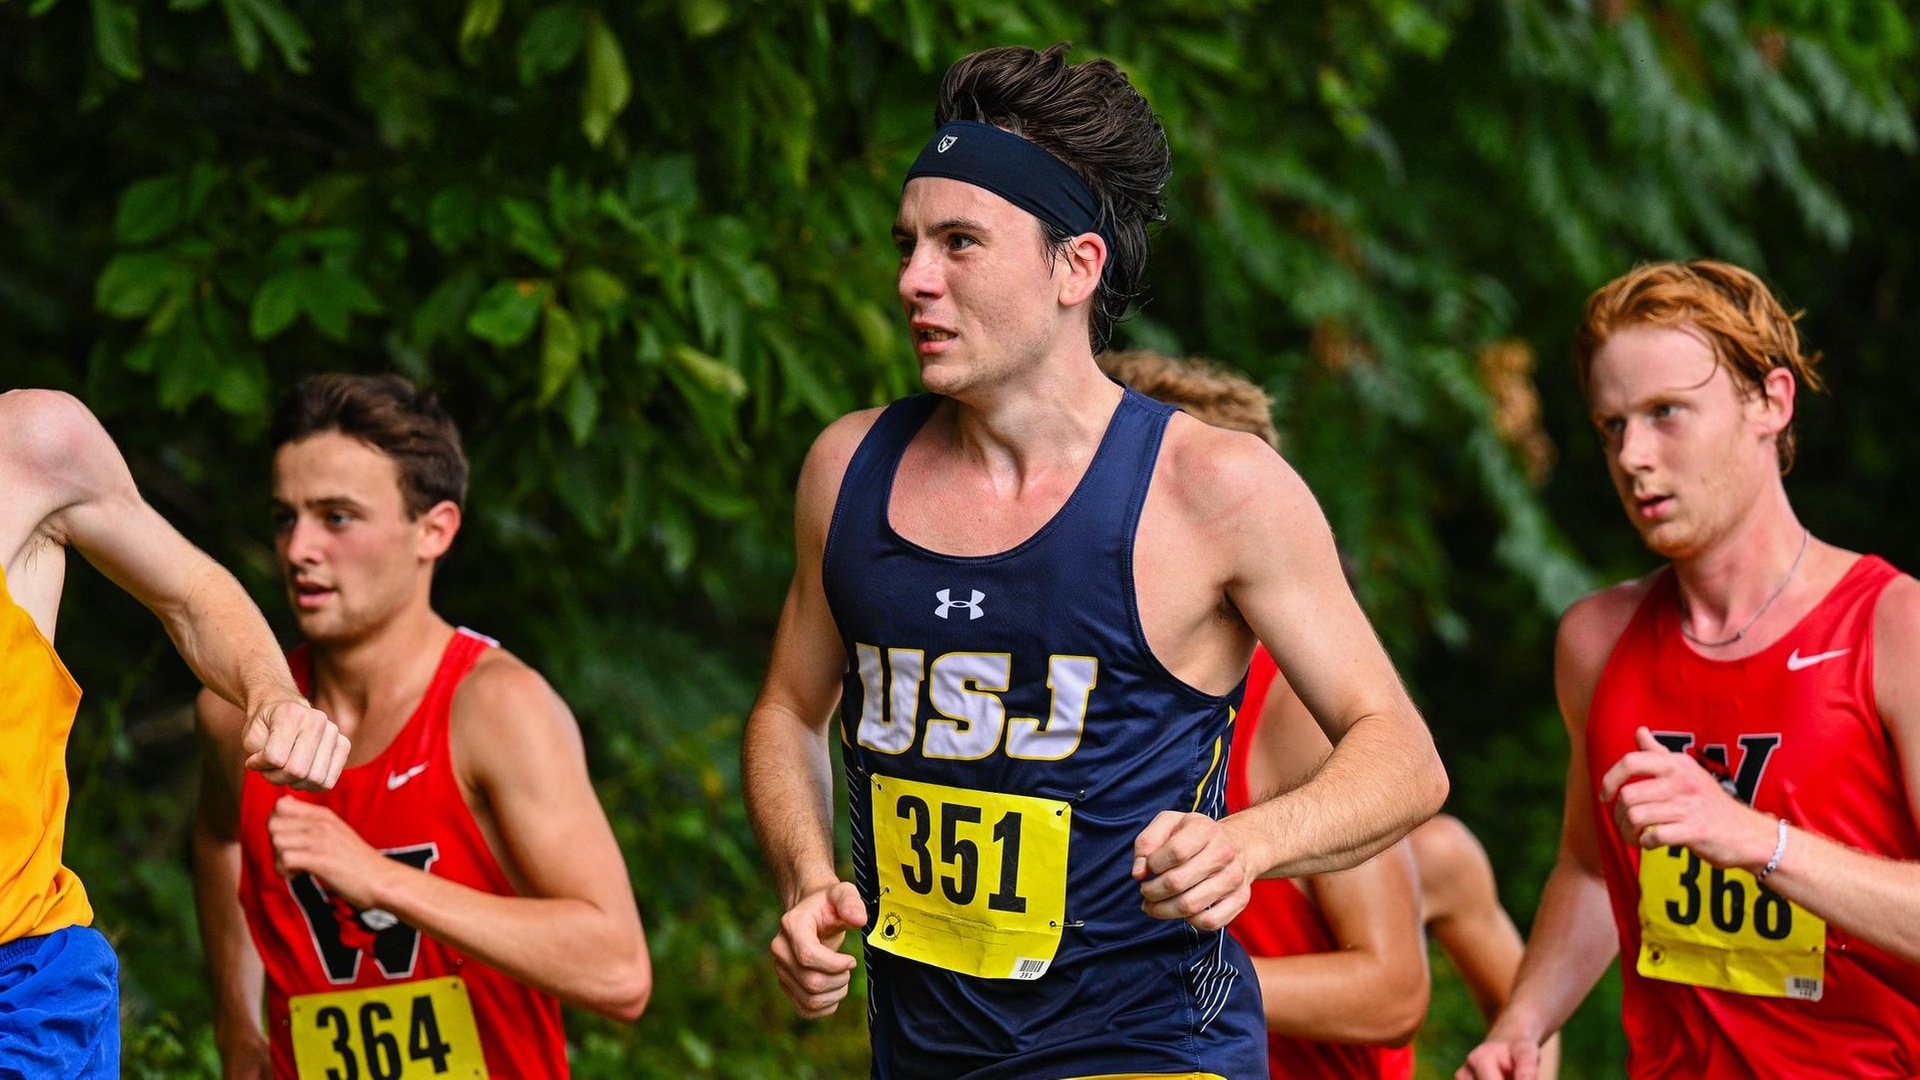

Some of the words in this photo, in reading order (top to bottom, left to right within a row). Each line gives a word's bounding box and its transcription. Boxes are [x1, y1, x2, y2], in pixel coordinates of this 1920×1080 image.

[855, 642, 1098, 760] USJ
[895, 795, 1026, 913] 351
[1664, 846, 1792, 940] 368
[315, 995, 451, 1080] 364
